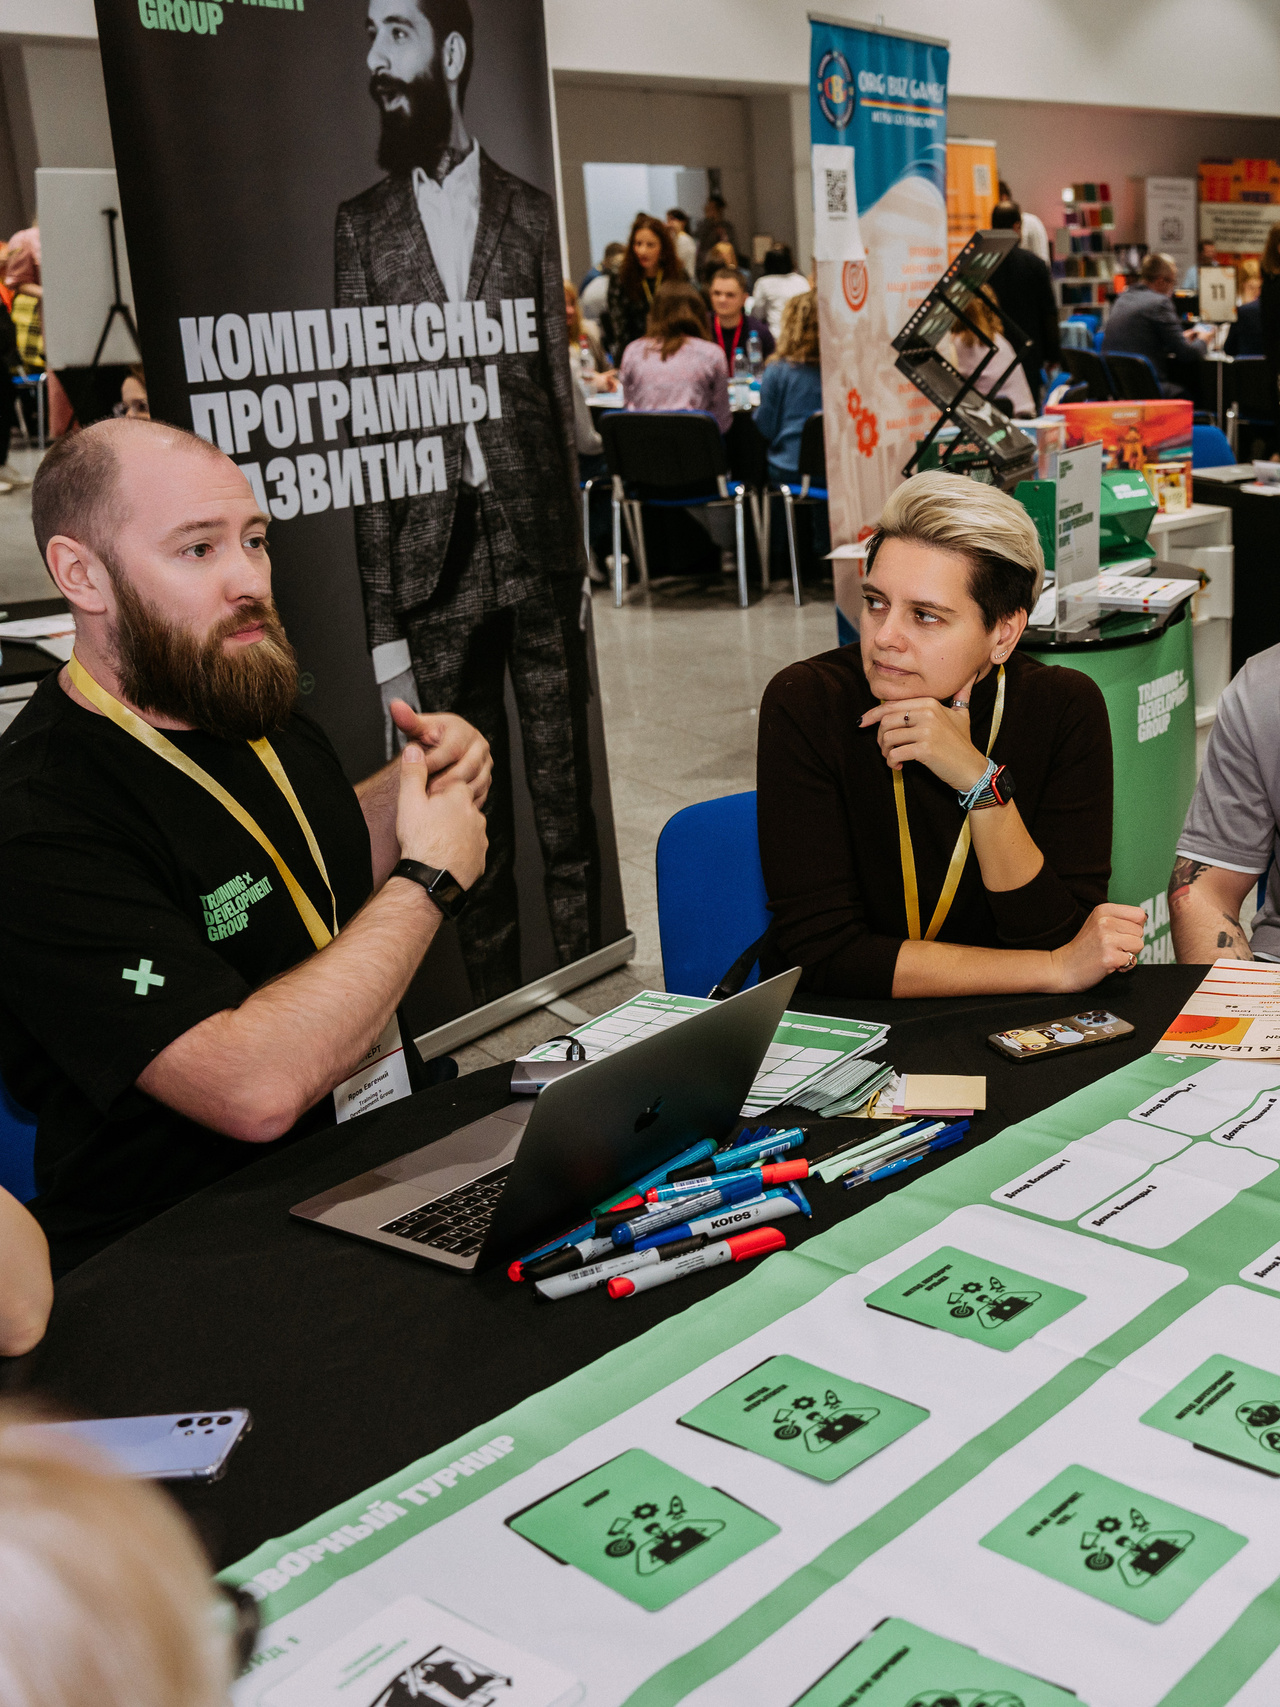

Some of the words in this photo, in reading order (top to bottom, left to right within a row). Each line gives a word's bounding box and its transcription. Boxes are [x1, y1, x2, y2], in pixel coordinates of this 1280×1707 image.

[138, 0, 224, 35] GROUP
[178, 297, 540, 384] КОМПЛЕКСНЫЕ
[189, 363, 502, 456] ПРОГРАММЫ
[238, 435, 448, 521] АЗВИТИЯ
[1138, 712, 1171, 743] GROUP
[199, 875, 248, 910] TRAINING
[203, 876, 273, 926] DEVELOPMENT
[207, 911, 249, 942] GROUP
[1190, 1043, 1253, 1053] LEARN
[347, 1089, 364, 1102] Яров
[363, 1070, 390, 1091] Евгений
[239, 1499, 408, 1600] ВОРНЫЙ
[397, 1434, 515, 1506] ТУРНИР
